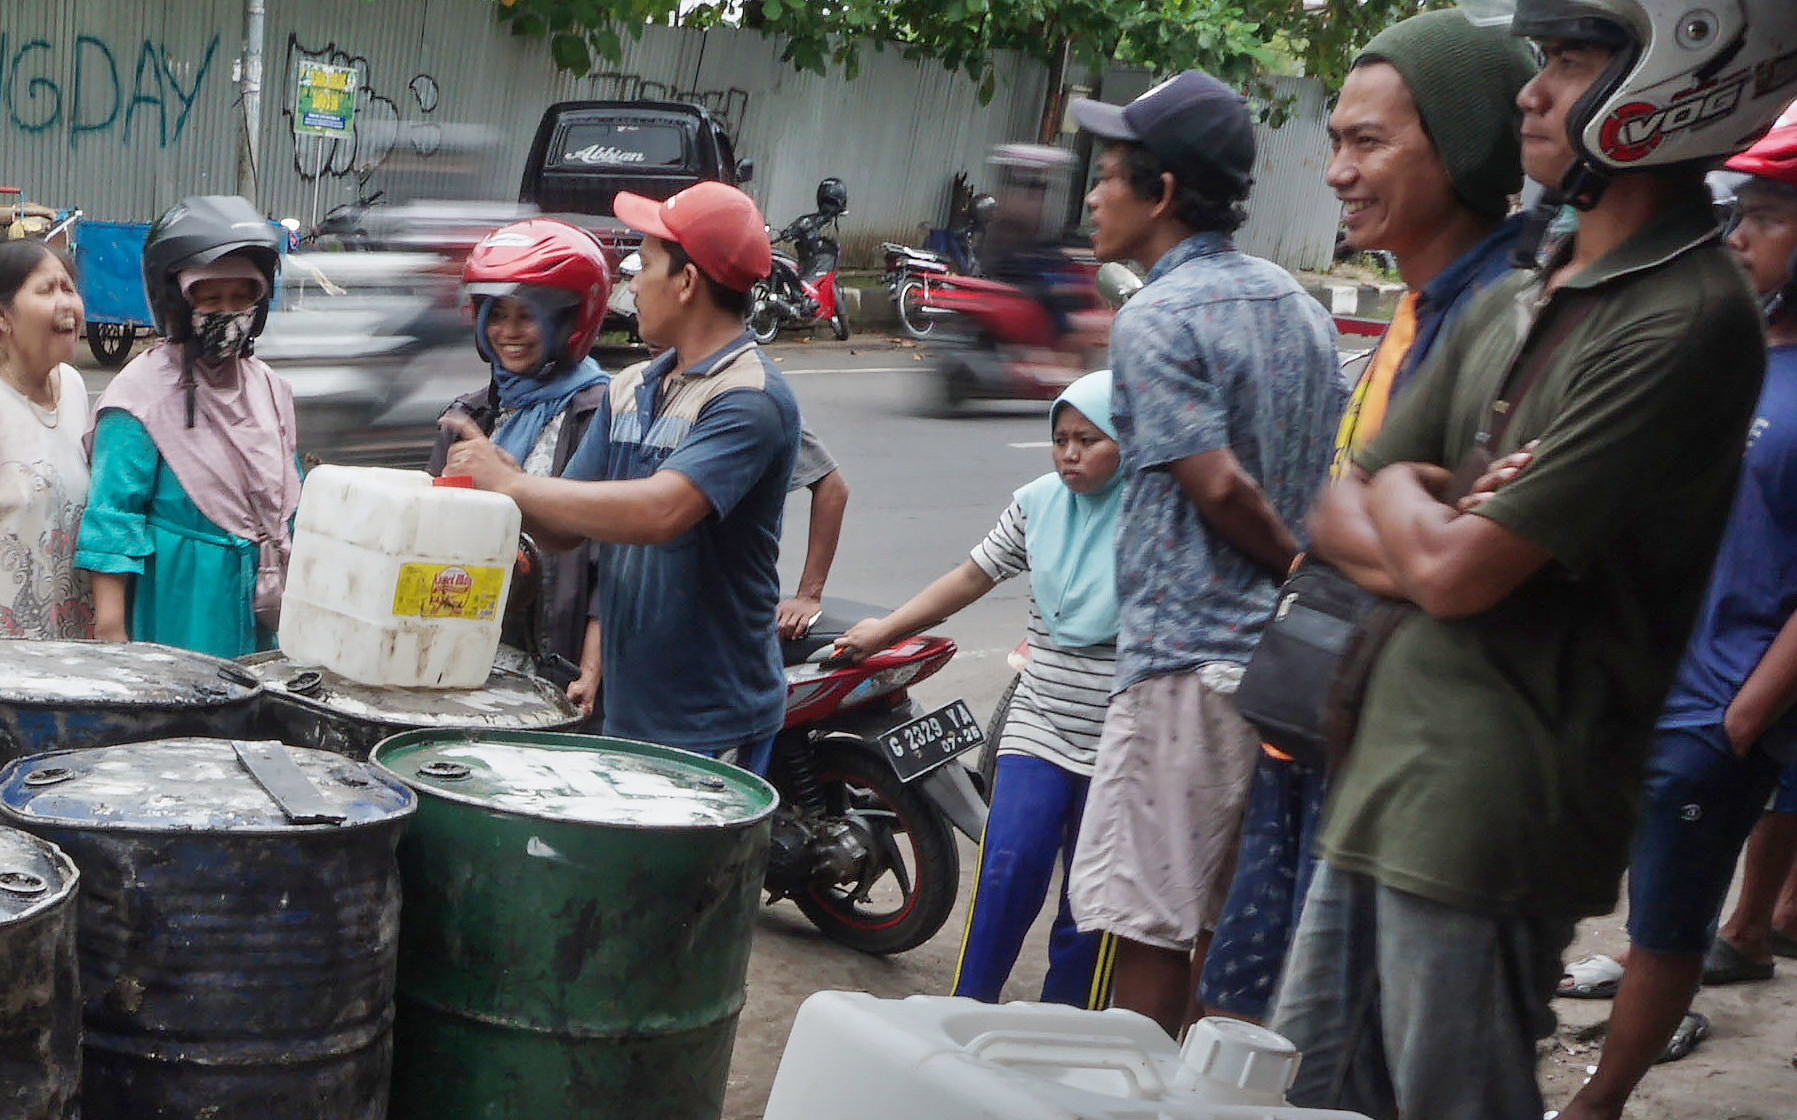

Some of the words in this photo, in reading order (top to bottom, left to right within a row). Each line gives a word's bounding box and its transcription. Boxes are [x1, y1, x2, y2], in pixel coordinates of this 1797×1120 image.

[888, 736, 904, 757] G
[904, 717, 943, 750] 2329
[945, 703, 972, 728] YA
